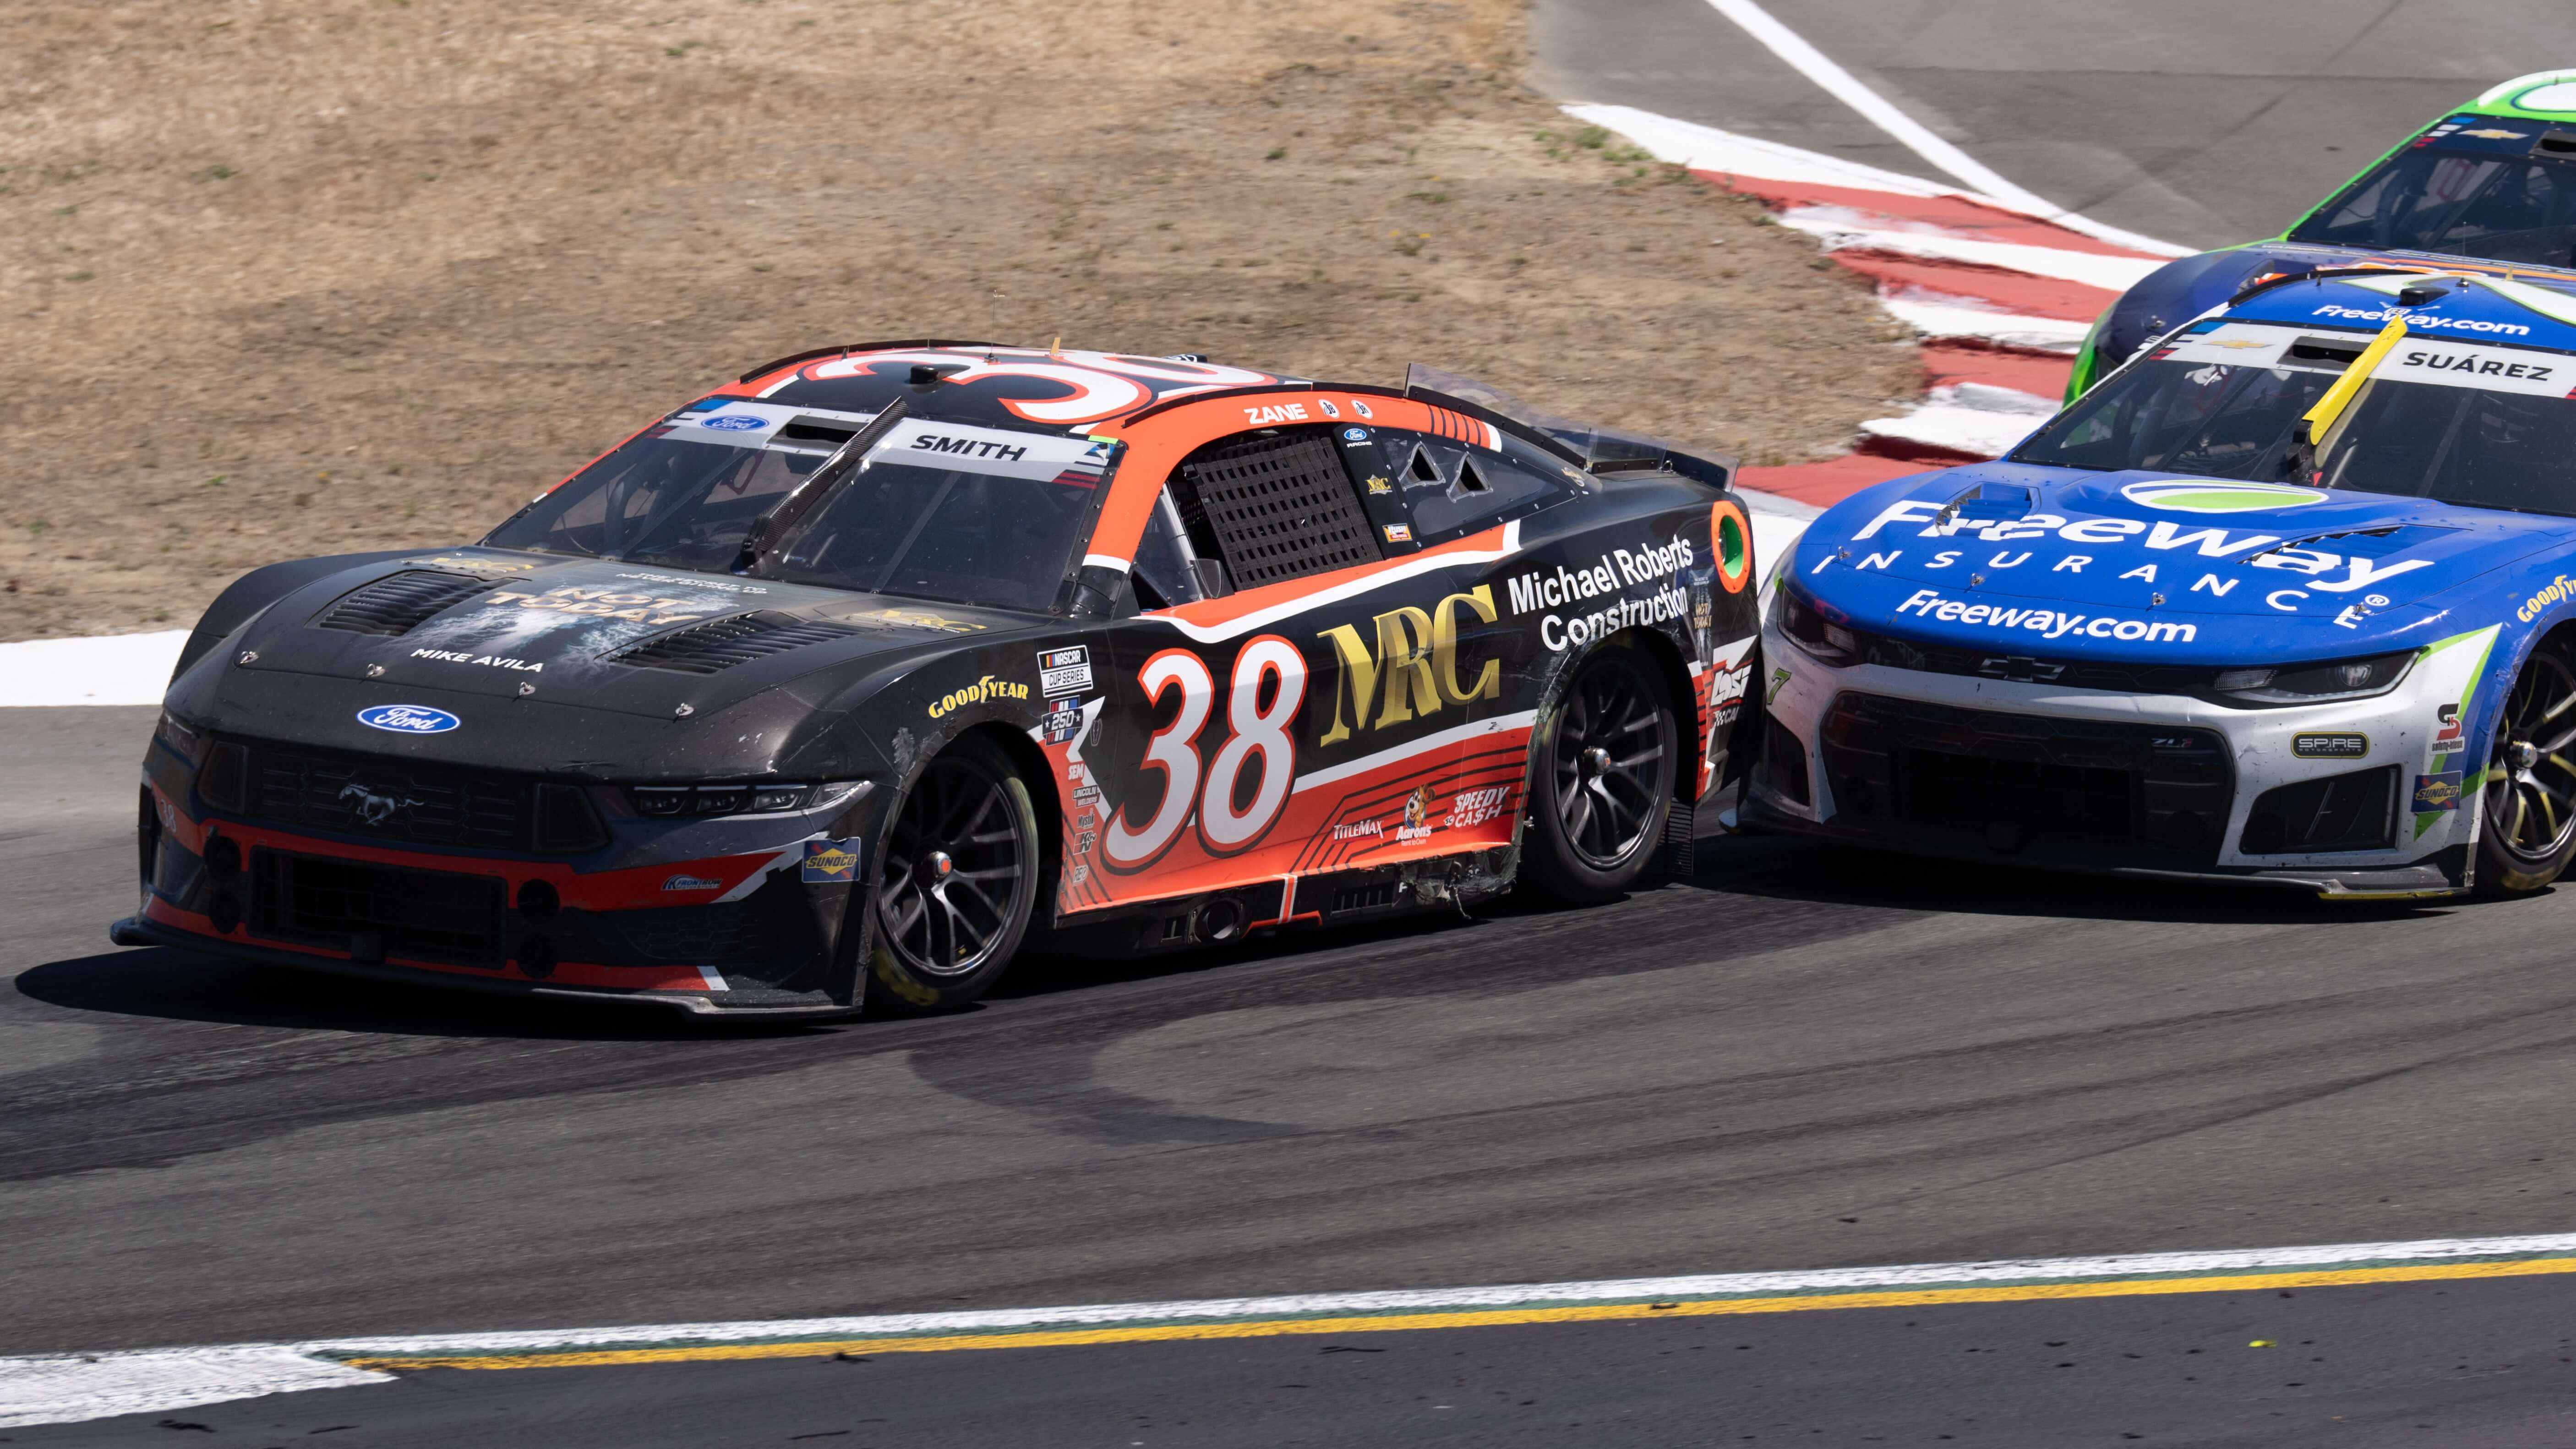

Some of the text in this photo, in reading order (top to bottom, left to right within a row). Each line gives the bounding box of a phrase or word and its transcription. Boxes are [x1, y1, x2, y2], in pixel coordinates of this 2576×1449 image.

[2312, 305, 2530, 335] Freeway.com
[2403, 352, 2554, 383] SUÁREZ
[711, 417, 759, 429] Ford
[1244, 403, 1308, 424] ZANE
[1349, 430, 1363, 439] Ford
[910, 434, 1027, 461] SMITH
[1850, 500, 2435, 592] Freeway
[1508, 534, 1693, 615] Michael Roberts
[485, 591, 703, 625] TODAY
[548, 588, 697, 609] NOT
[1541, 583, 1689, 651] Construction
[1896, 589, 2197, 642] Freeway.com
[410, 649, 545, 673] MIKE AVILA
[1055, 650, 1081, 666] NASCAR
[1316, 584, 1500, 748] MRC
[1049, 669, 1084, 686] CUP SERIES
[1767, 667, 1791, 705] 7
[928, 680, 1029, 718] GOODYEAR
[373, 706, 442, 730] Ford
[1052, 711, 1075, 730] 250
[1100, 634, 1309, 873] 38
[2432, 739, 2463, 752] safety-kleen
[1068, 764, 1084, 780] SEM
[1073, 787, 1097, 798] LINCOLN
[1454, 786, 1510, 813] SPEEDY
[2417, 786, 2458, 799] SUNOCO
[1077, 814, 1094, 827] Mystik
[1454, 804, 1502, 828] CA$H
[1395, 824, 1432, 841] Aaron's
[807, 855, 855, 868] SUNOCO
